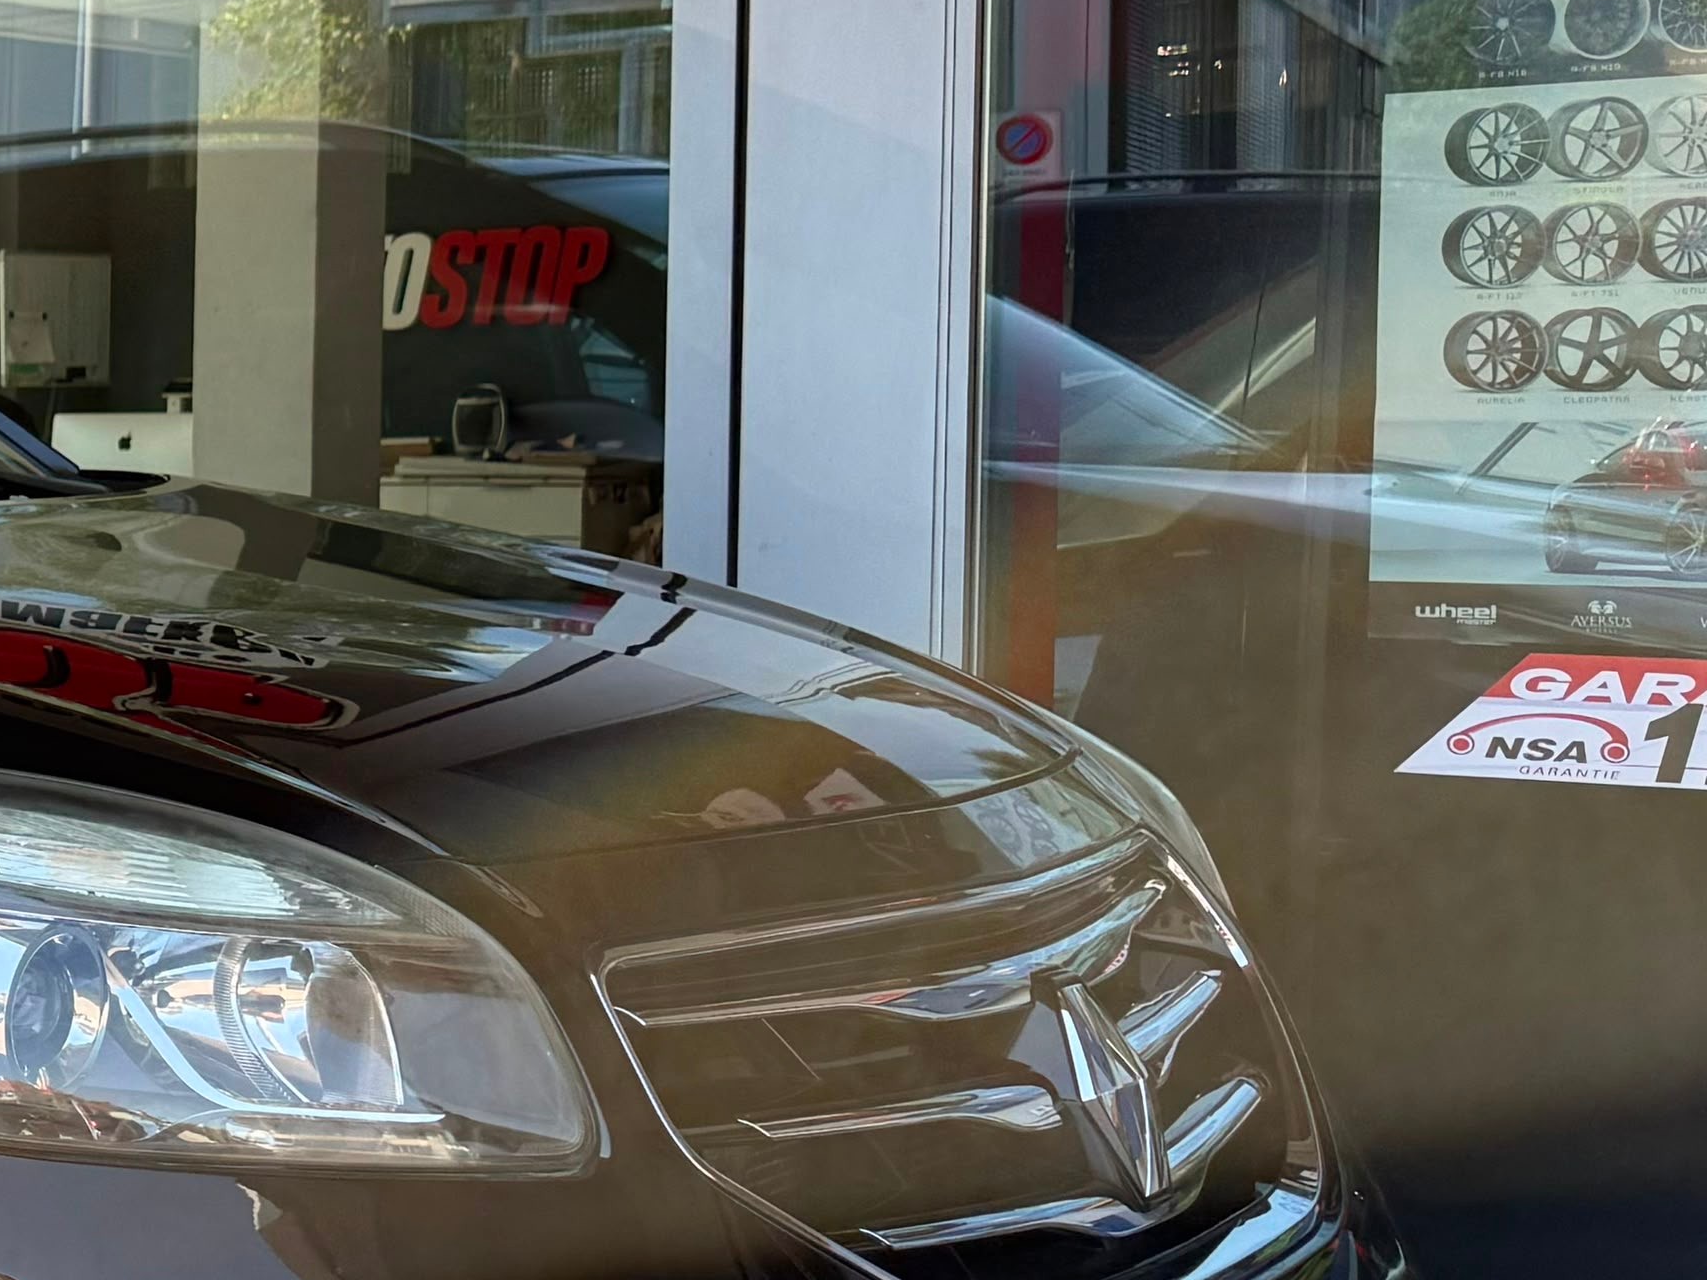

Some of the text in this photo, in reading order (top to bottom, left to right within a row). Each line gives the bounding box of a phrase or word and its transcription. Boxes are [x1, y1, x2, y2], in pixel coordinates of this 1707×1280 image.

[382, 225, 610, 331] OSTOP
[1415, 603, 1497, 619] wheel
[1510, 667, 1707, 706] GAR
[1485, 736, 1587, 764] NSA
[1644, 703, 1707, 783] 1
[1518, 765, 1620, 781] GARANTIE
